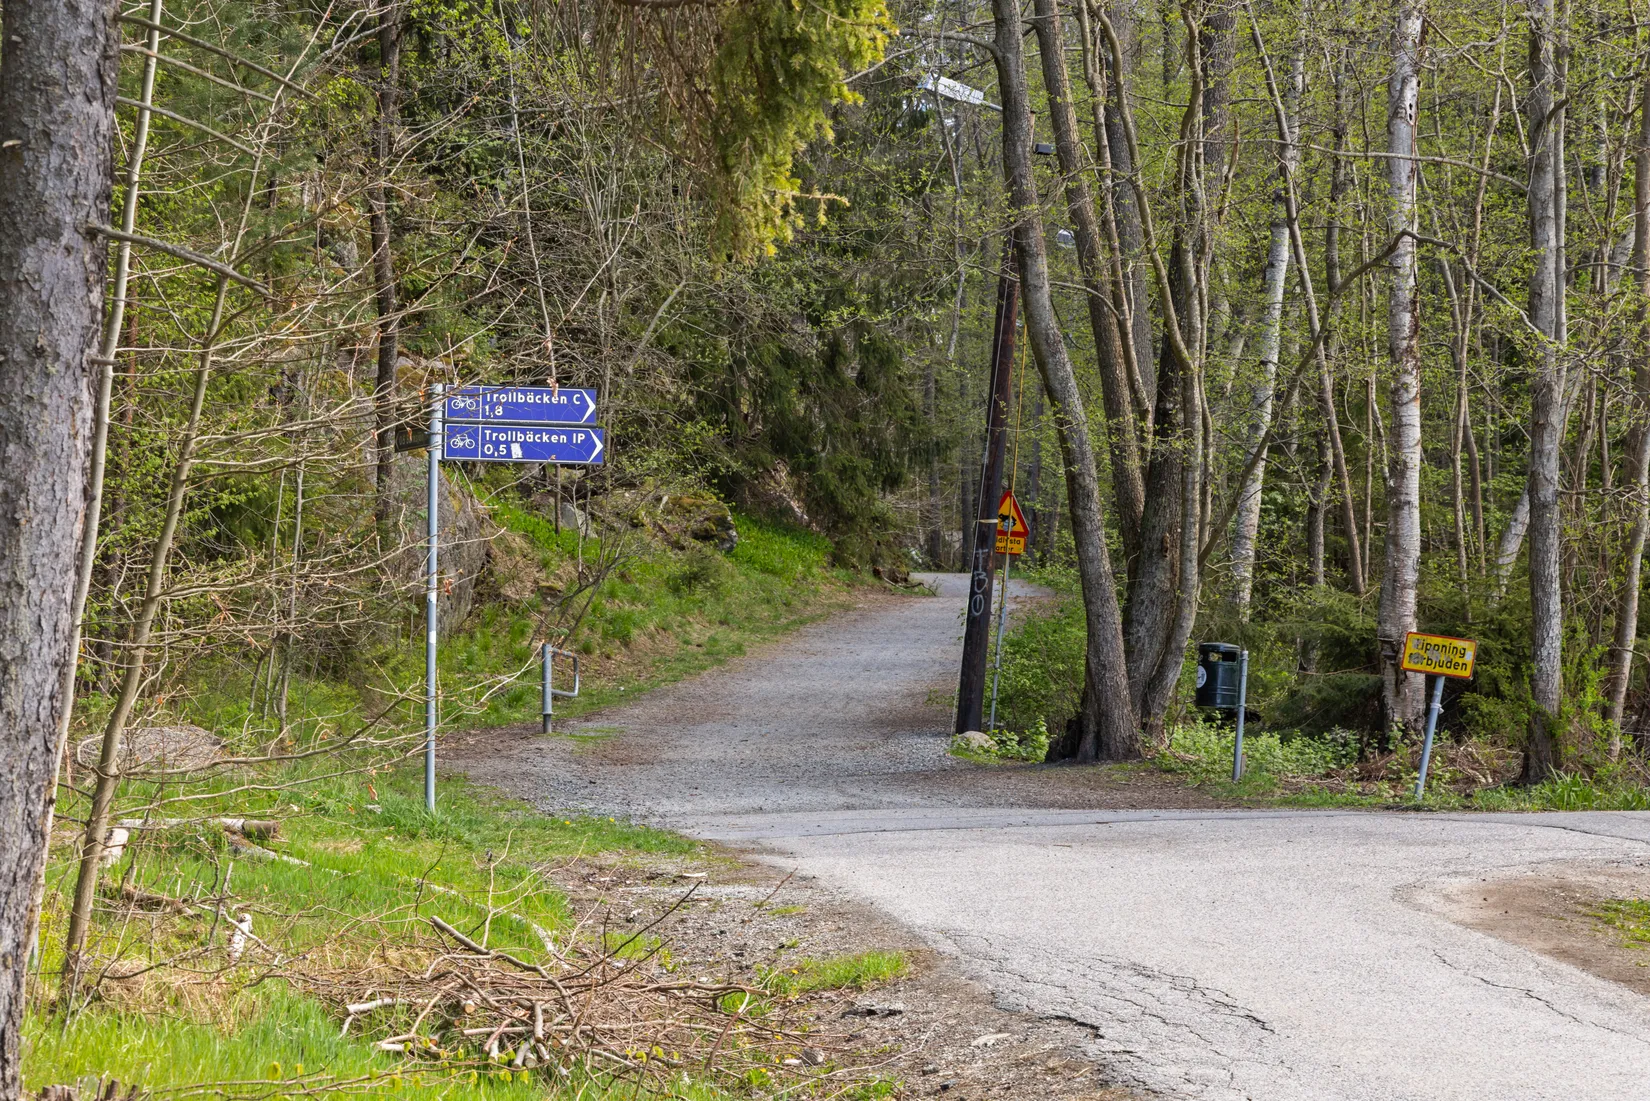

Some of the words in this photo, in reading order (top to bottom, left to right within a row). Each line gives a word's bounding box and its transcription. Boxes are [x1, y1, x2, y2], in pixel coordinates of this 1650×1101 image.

[486, 391, 568, 404] Trollbäcken
[573, 394, 581, 405] C
[485, 406, 504, 418] 1,8
[484, 430, 567, 444] Trollbäcken
[572, 433, 586, 444] IP
[484, 444, 507, 457] 0,5
